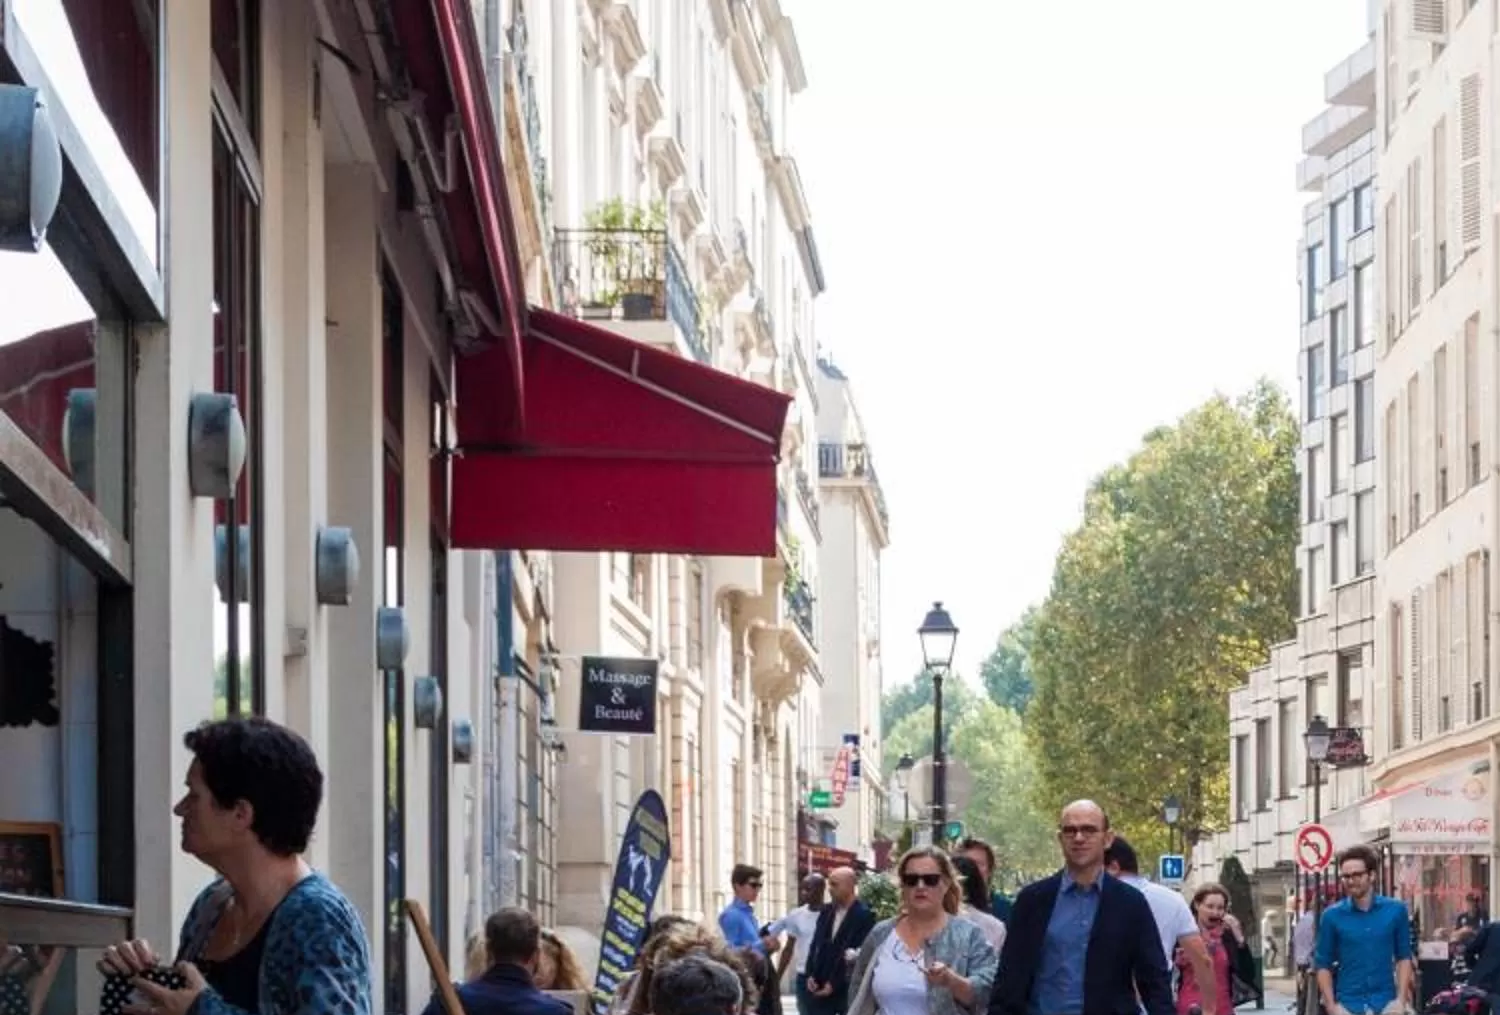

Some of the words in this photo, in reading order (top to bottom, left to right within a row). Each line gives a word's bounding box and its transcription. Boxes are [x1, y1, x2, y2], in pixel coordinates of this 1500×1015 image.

[588, 668, 653, 688] Massage
[611, 687, 626, 705] &
[595, 704, 645, 721] Beauté
